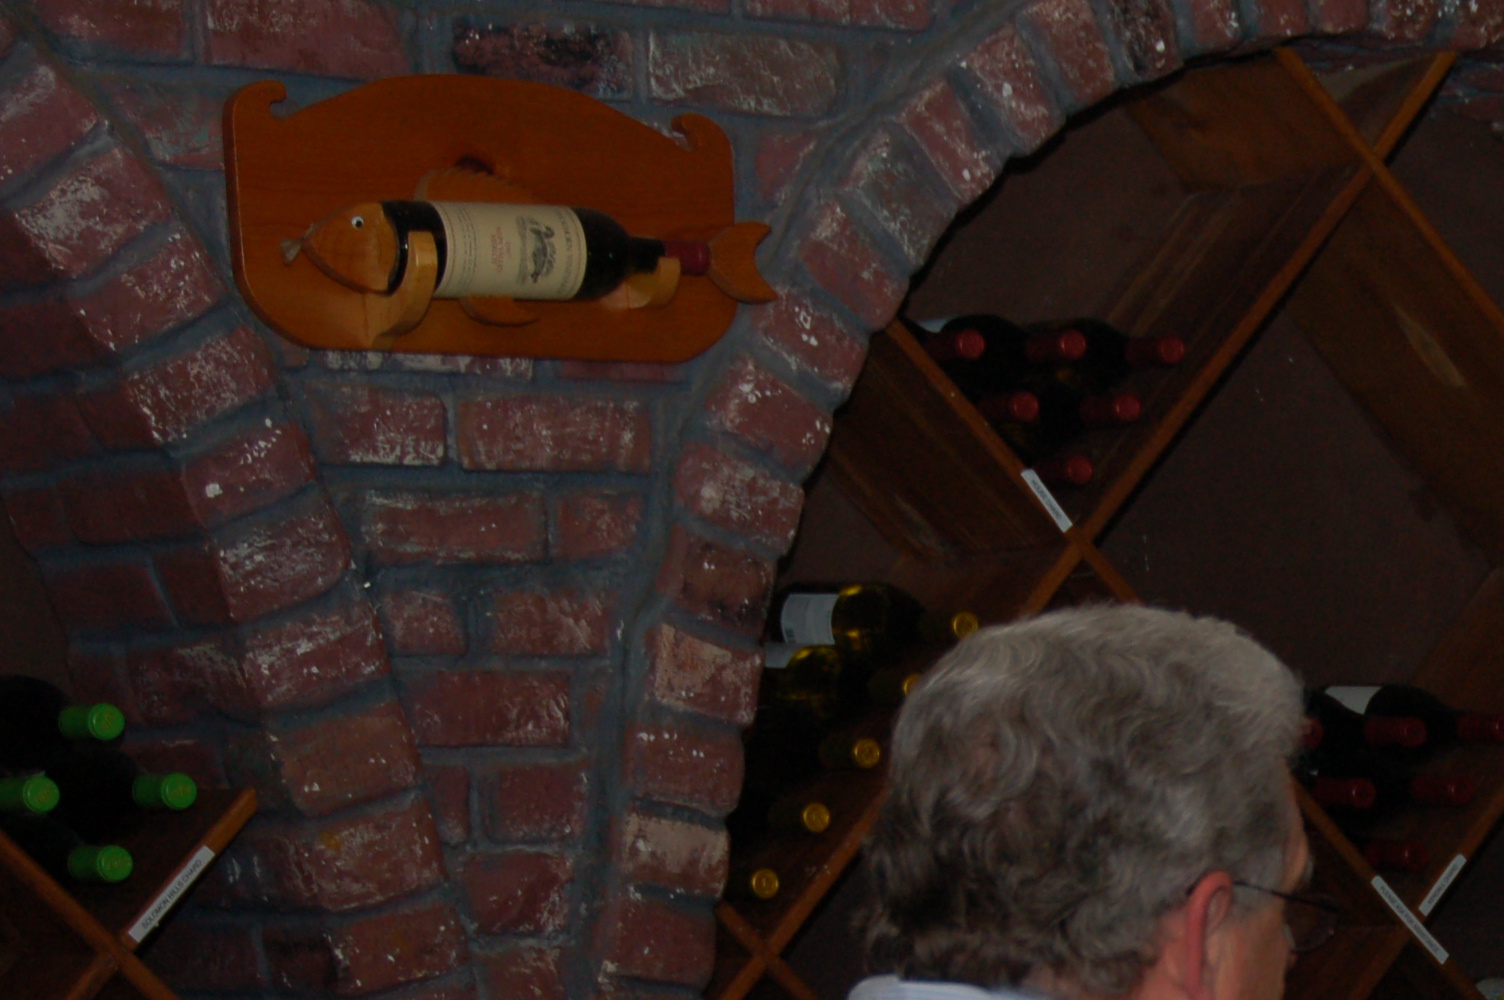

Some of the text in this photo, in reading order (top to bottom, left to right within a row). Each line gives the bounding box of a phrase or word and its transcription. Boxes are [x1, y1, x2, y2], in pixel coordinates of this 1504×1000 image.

[140, 859, 202, 929] SOLOMON HILLS CHARD
